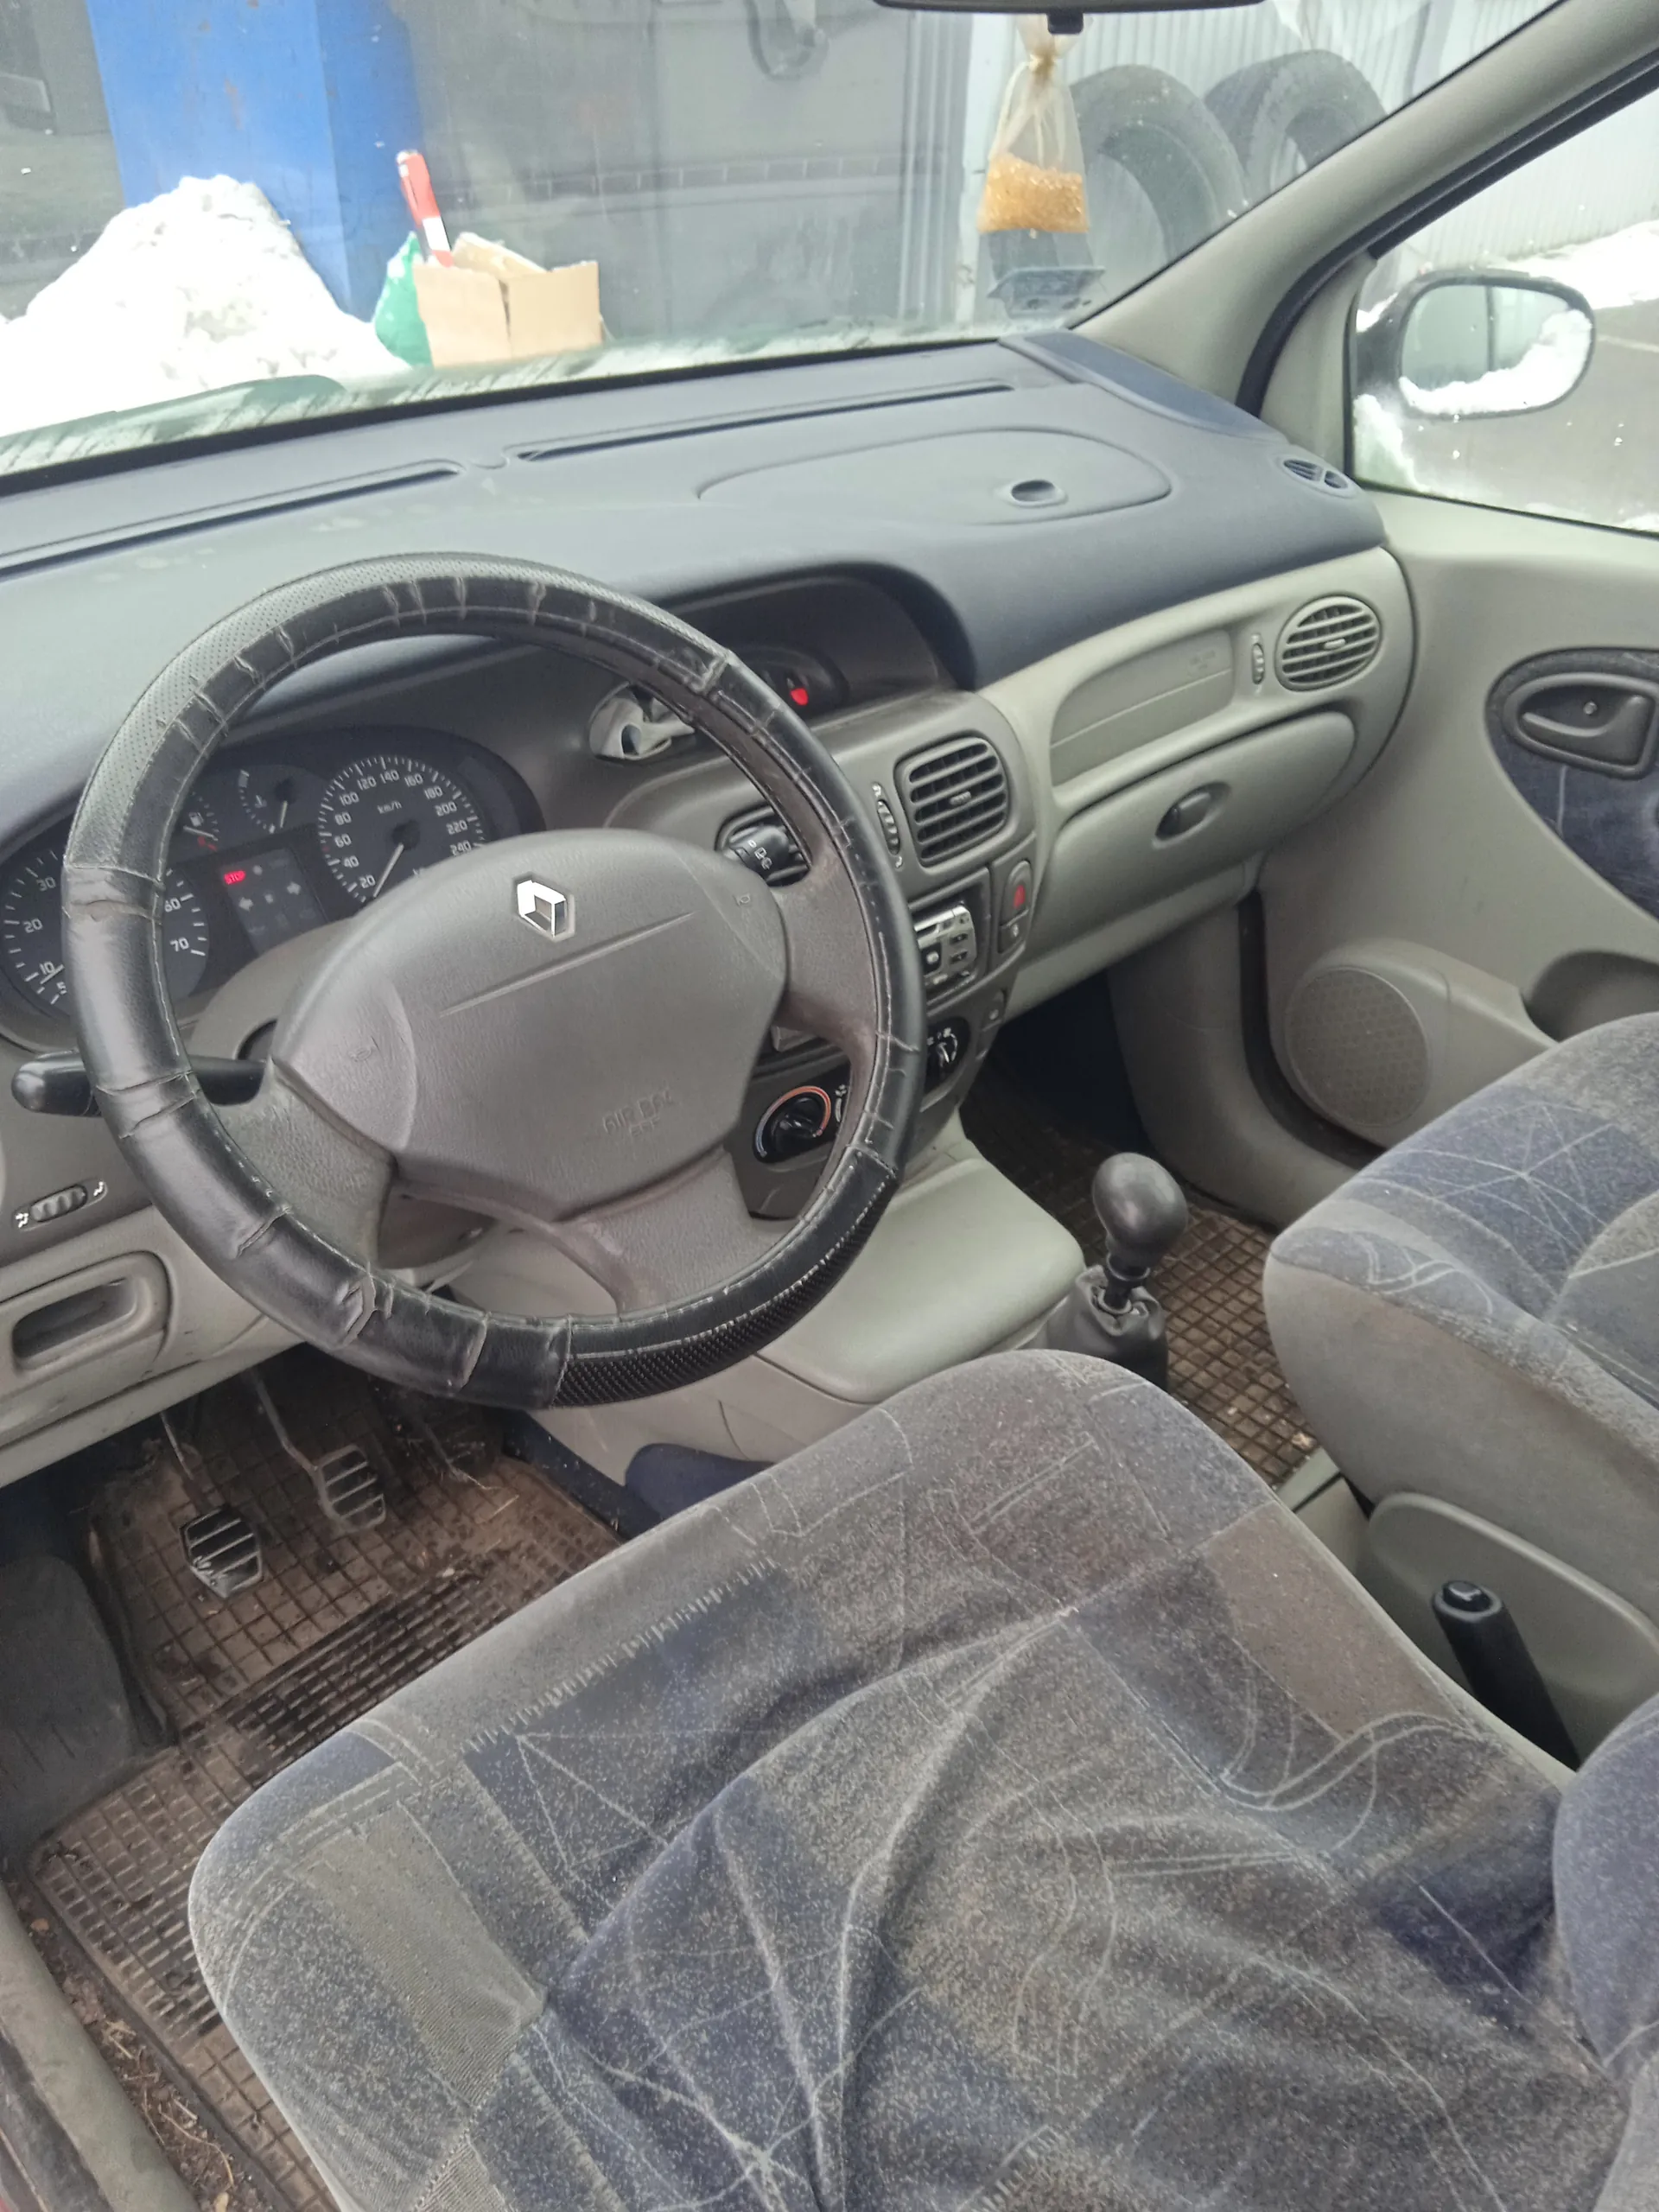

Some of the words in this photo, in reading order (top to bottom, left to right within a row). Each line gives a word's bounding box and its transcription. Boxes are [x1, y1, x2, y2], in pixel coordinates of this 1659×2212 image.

[357, 776, 378, 791] 120
[379, 769, 400, 785] 140
[339, 791, 359, 806] 100
[377, 800, 403, 814] km/h
[435, 801, 458, 817] 200
[446, 819, 468, 836] 220
[449, 839, 473, 856] 240
[36, 877, 57, 891] 30
[359, 874, 377, 889] 20
[164, 897, 181, 912] 60
[23, 918, 43, 933] 20
[169, 937, 190, 952] 70
